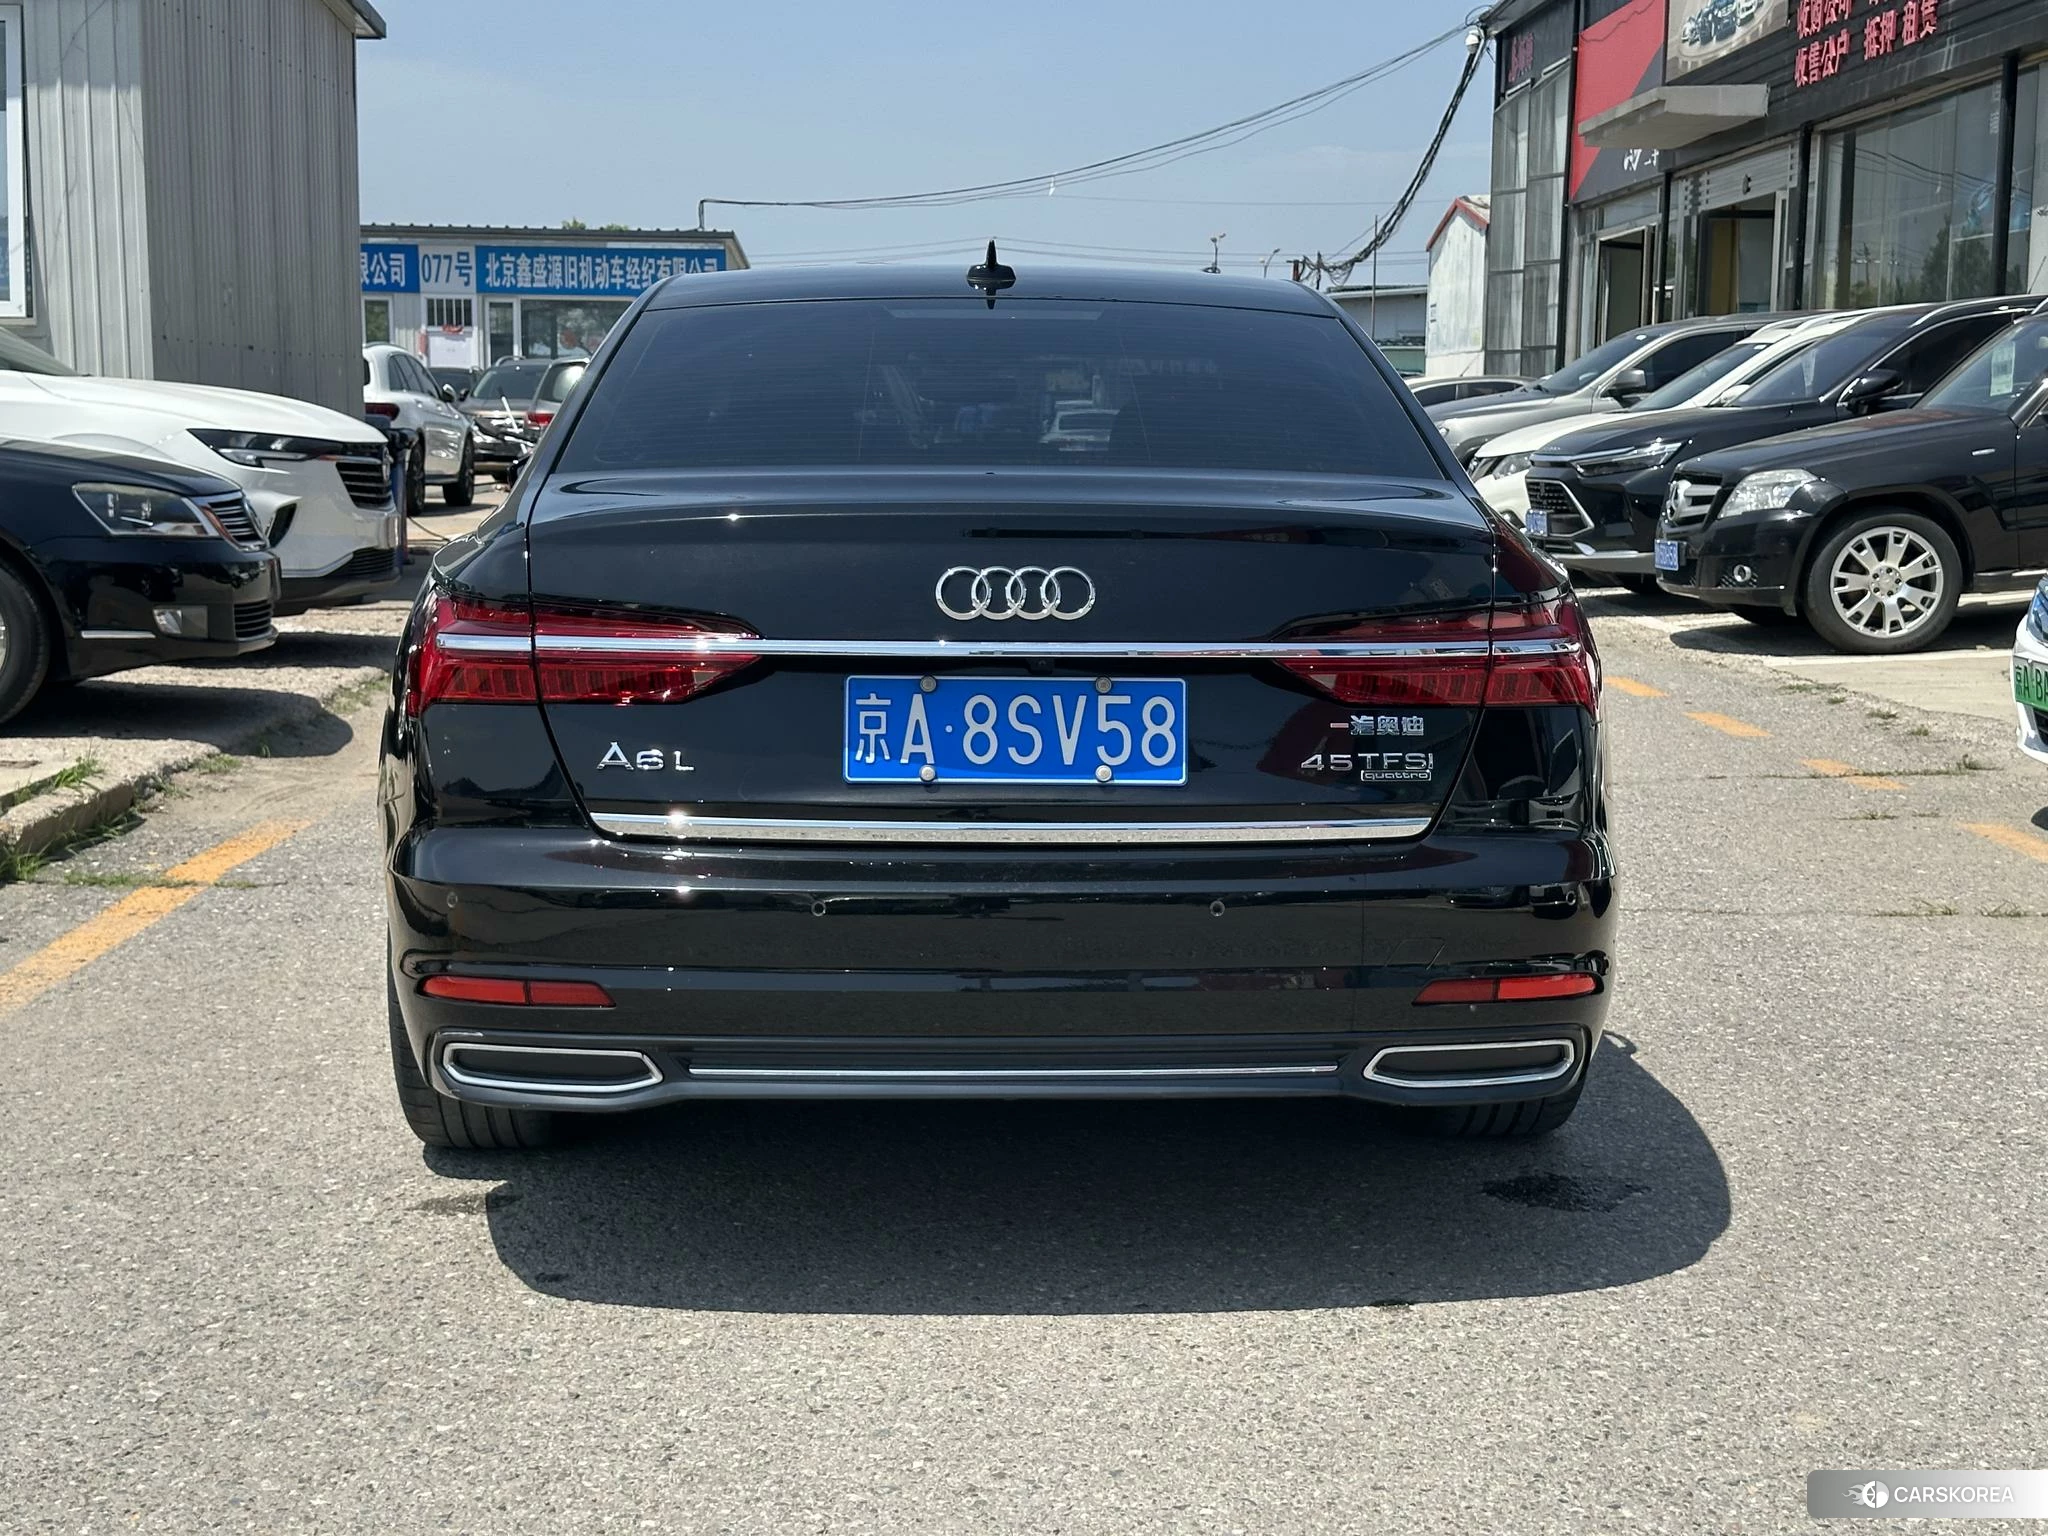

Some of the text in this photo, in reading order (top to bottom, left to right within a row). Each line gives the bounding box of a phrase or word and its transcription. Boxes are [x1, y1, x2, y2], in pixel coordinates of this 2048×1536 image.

[421, 251, 472, 287] 077号
[855, 693, 1177, 767] 京A·8SV58
[1330, 715, 1424, 736] 一汽奥迪
[1364, 771, 1429, 780] quattro
